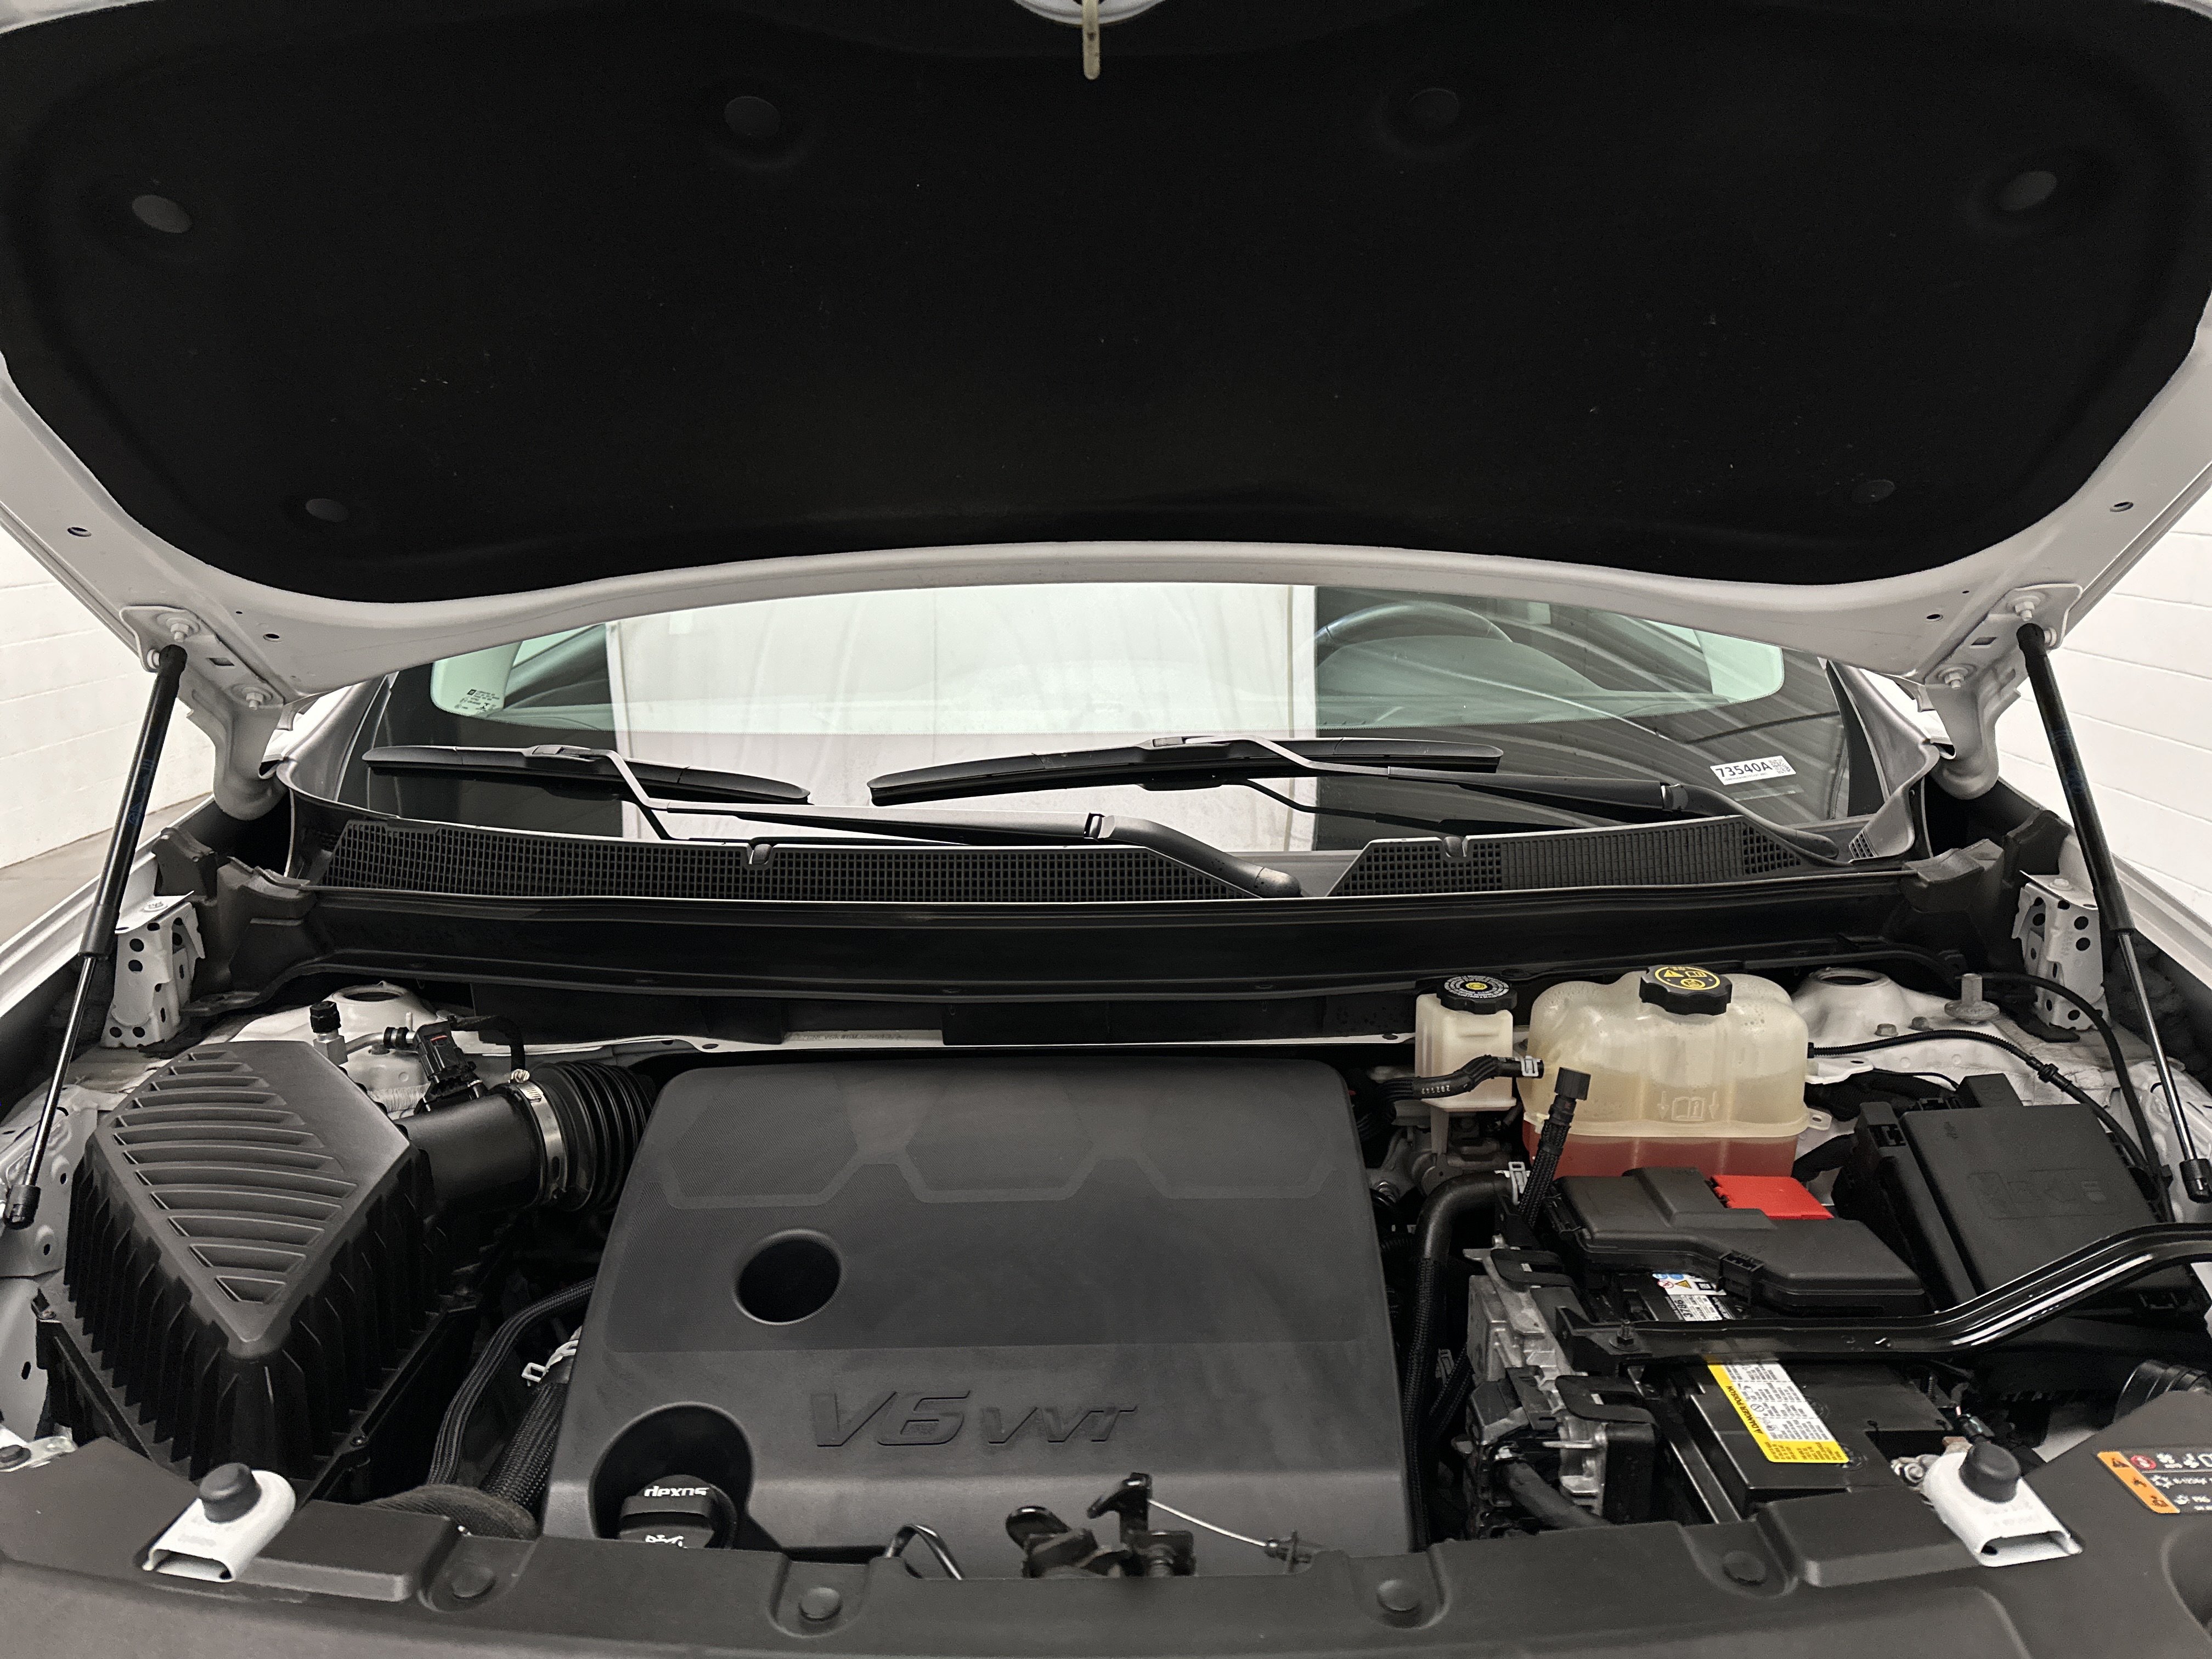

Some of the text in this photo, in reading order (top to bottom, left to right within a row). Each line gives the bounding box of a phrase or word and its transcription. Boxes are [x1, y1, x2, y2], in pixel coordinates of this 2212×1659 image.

[1715, 761, 1773, 777] 73540A
[1674, 1300, 1693, 1318] 3786
[810, 1390, 1138, 1447] V6 VVT
